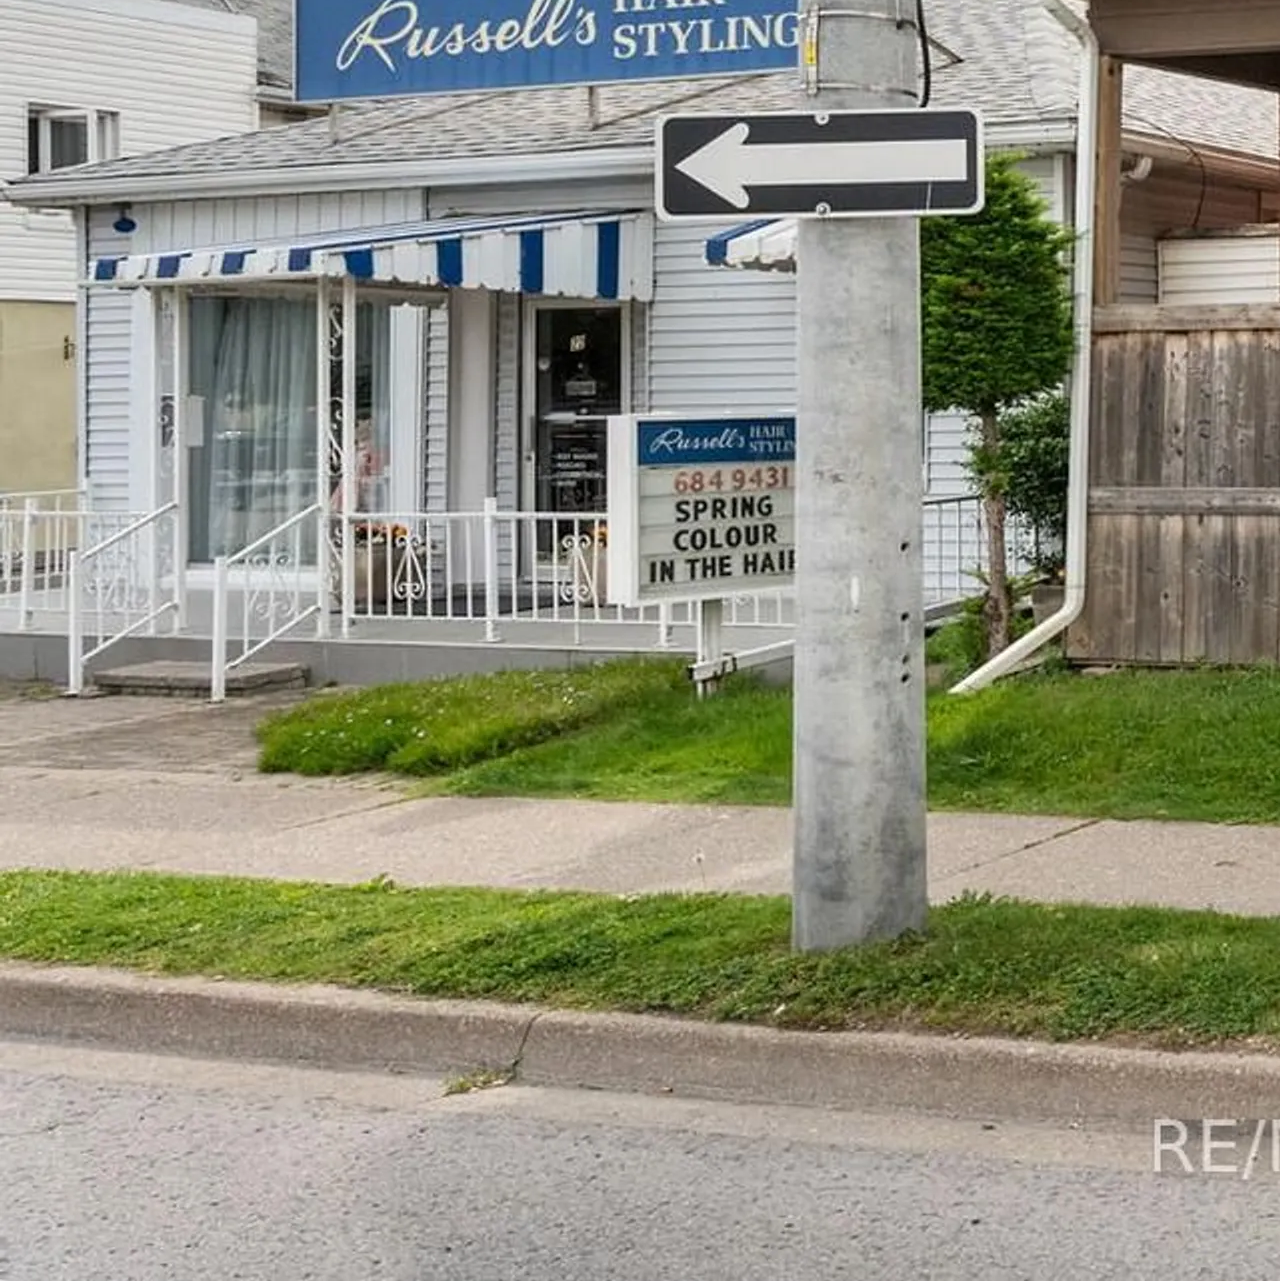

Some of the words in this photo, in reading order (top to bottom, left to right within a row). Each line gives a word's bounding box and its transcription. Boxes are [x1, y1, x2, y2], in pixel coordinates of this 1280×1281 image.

[612, 12, 799, 59] STYLING
[650, 427, 745, 454] Russell's
[750, 425, 786, 438] HAIR
[674, 470, 724, 494] 684
[731, 466, 790, 490] 9431
[675, 495, 773, 523] SPRING
[673, 523, 777, 552] COLOUR
[650, 559, 675, 584] IN
[685, 555, 732, 581] THE
